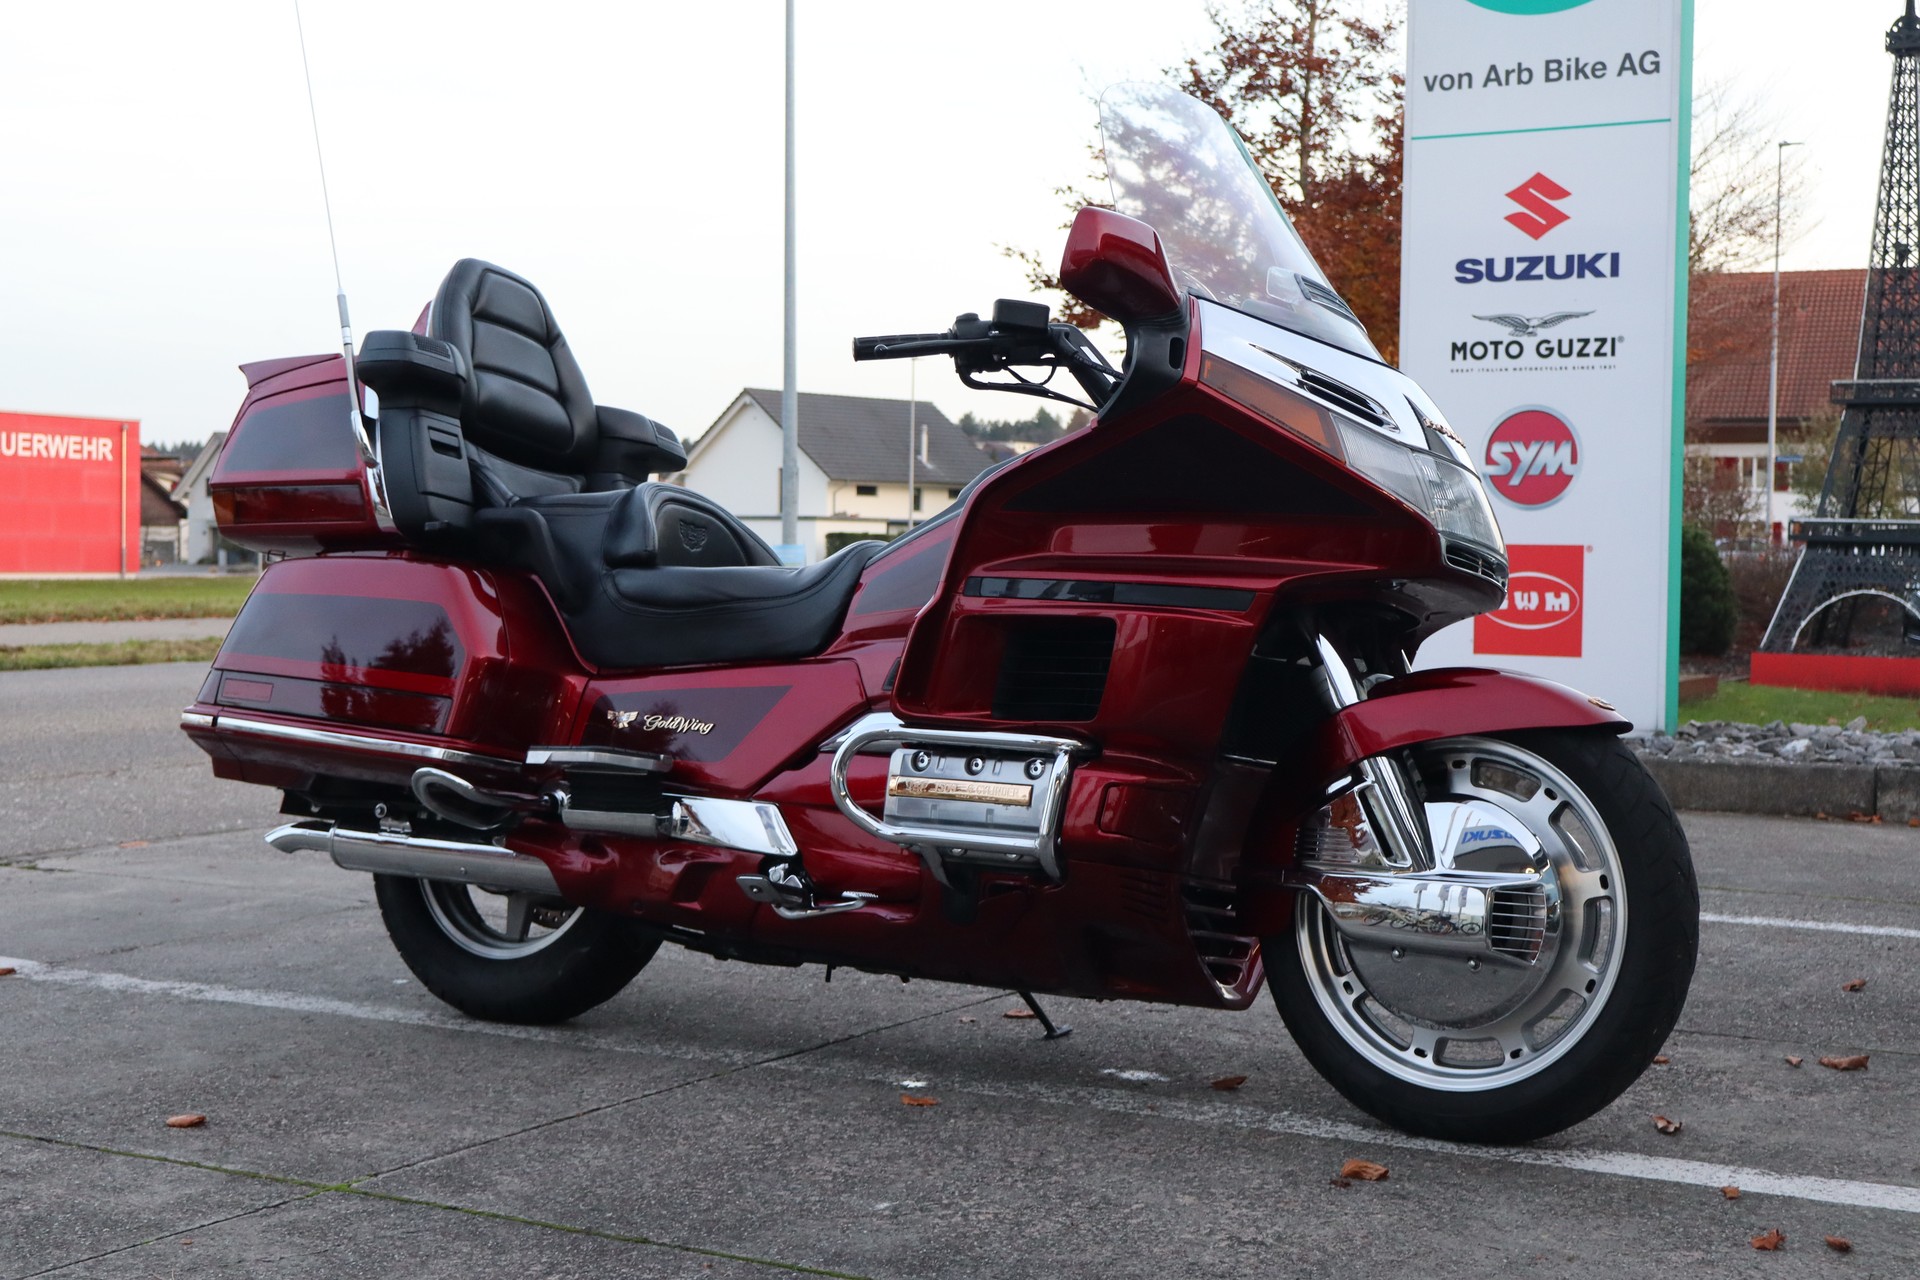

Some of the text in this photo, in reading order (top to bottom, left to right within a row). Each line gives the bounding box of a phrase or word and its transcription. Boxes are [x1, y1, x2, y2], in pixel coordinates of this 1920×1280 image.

[1423, 50, 1661, 92] von Arb Bike AG
[1454, 252, 1620, 284] SUZUKI
[1450, 337, 1616, 361] MOTO GUZZI
[0, 431, 113, 461] UERWEHR
[1485, 440, 1577, 486] SYM
[1499, 590, 1571, 611] WM
